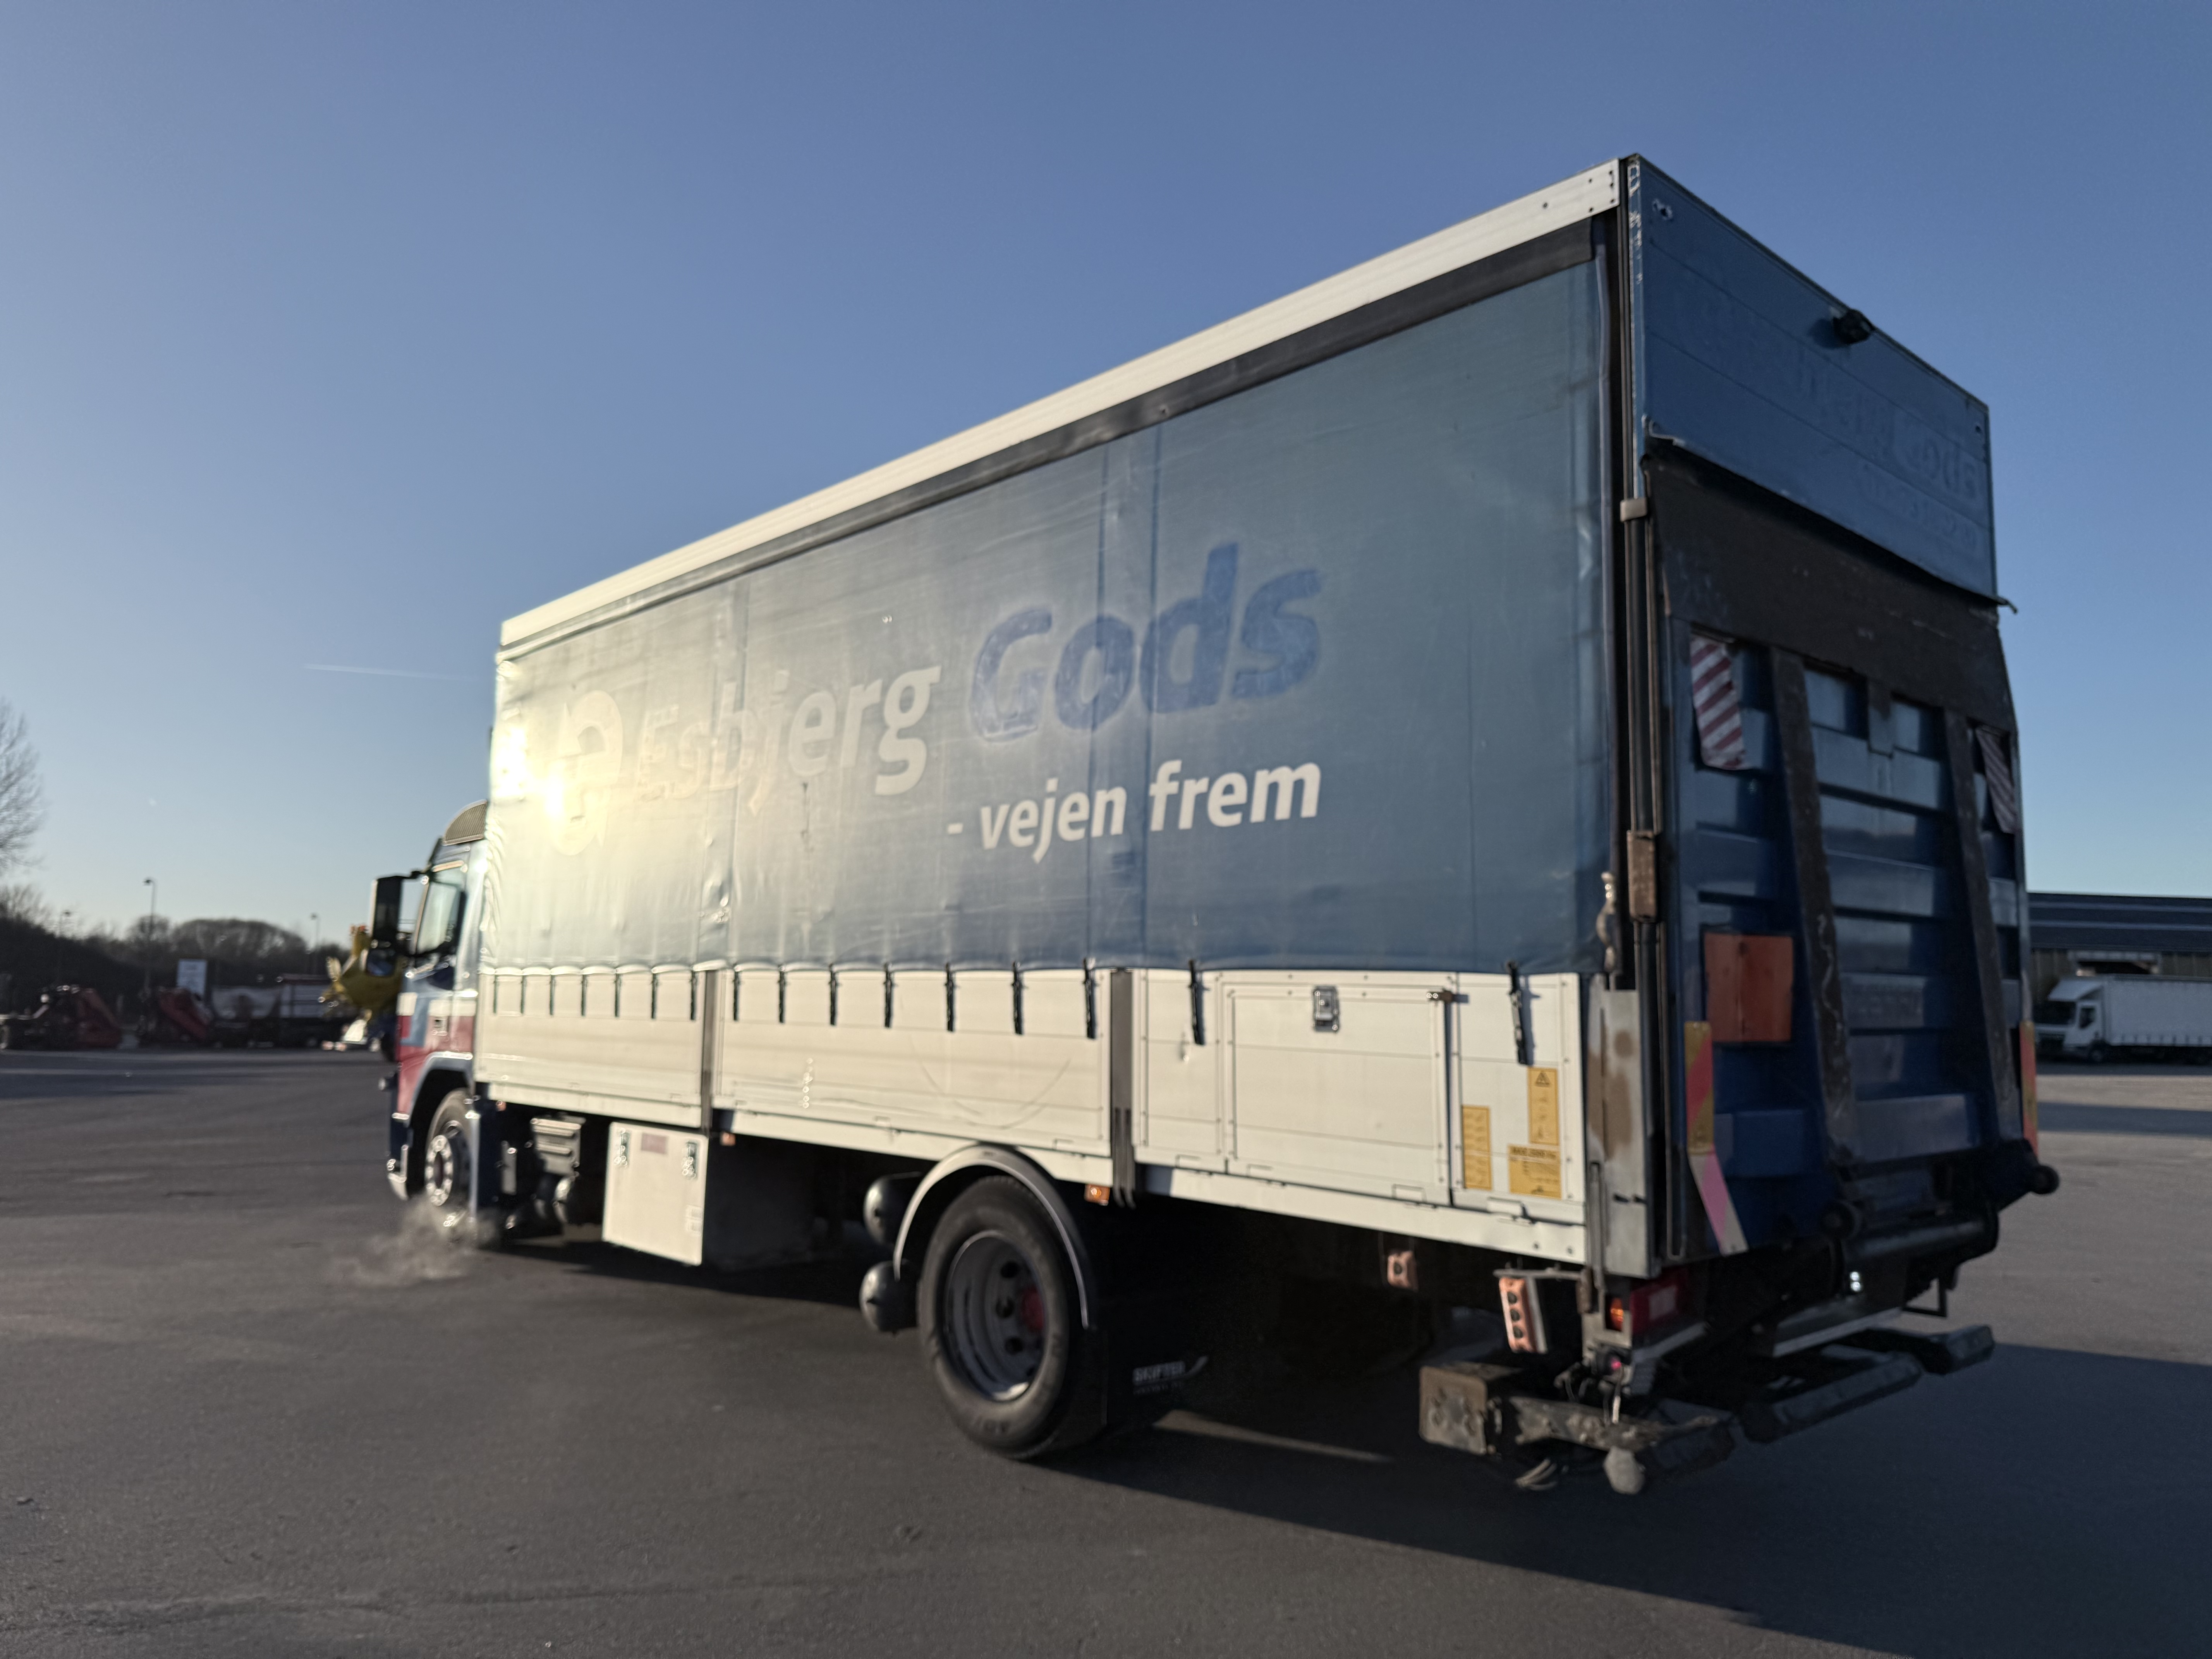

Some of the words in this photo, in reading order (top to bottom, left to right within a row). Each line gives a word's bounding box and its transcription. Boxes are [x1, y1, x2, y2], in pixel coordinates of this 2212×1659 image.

[635, 665, 941, 817] Esbjerg
[970, 543, 1321, 742] Gods
[981, 777, 1127, 863] vejen
[1149, 759, 1321, 831] frem
